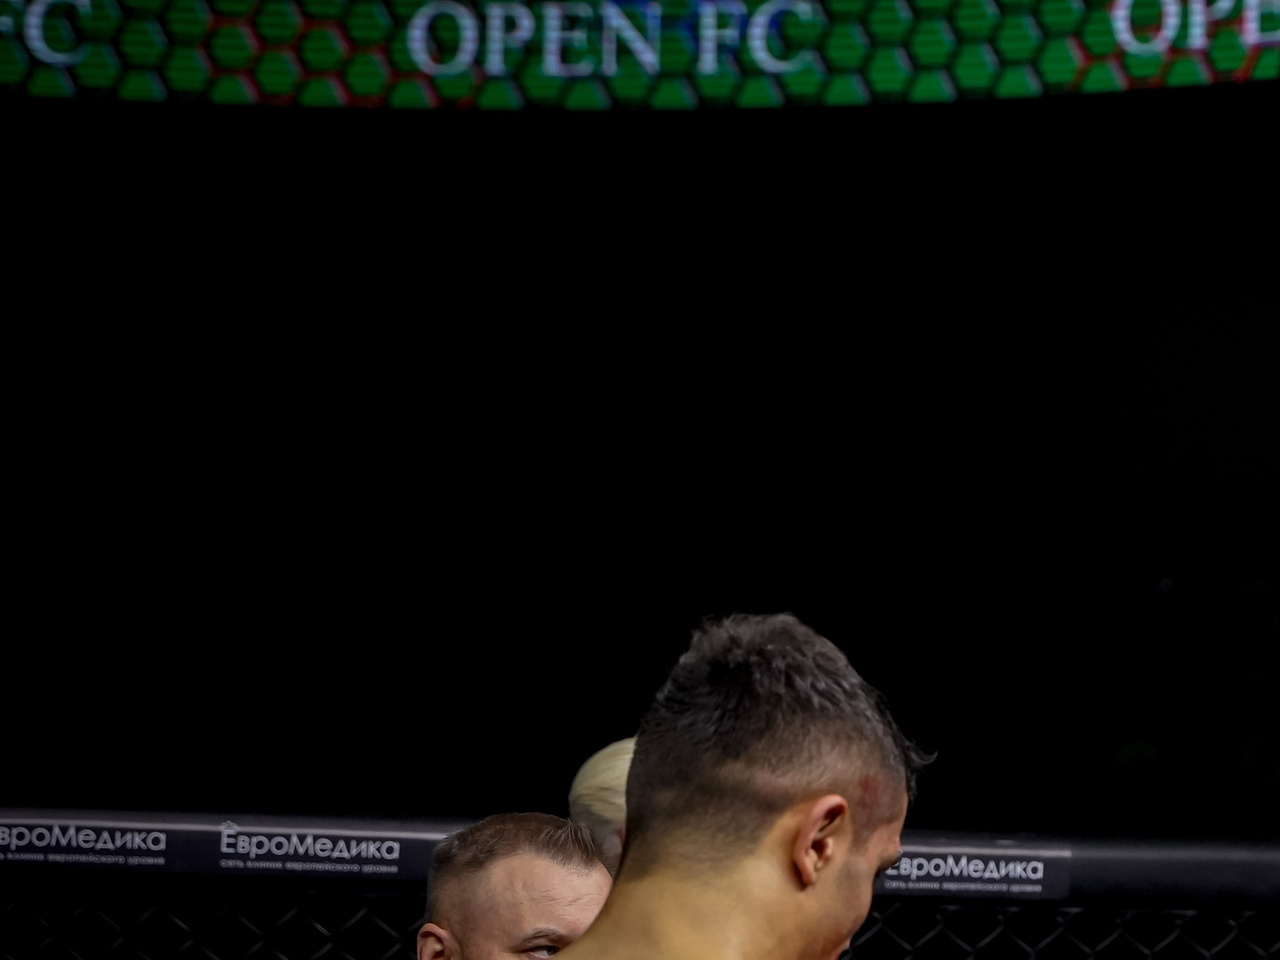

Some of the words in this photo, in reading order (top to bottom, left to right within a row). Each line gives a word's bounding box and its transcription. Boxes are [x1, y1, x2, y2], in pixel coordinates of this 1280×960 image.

[406, 0, 661, 77] OPEN
[696, 0, 818, 74] FC
[220, 828, 400, 860] ЕвроМедика
